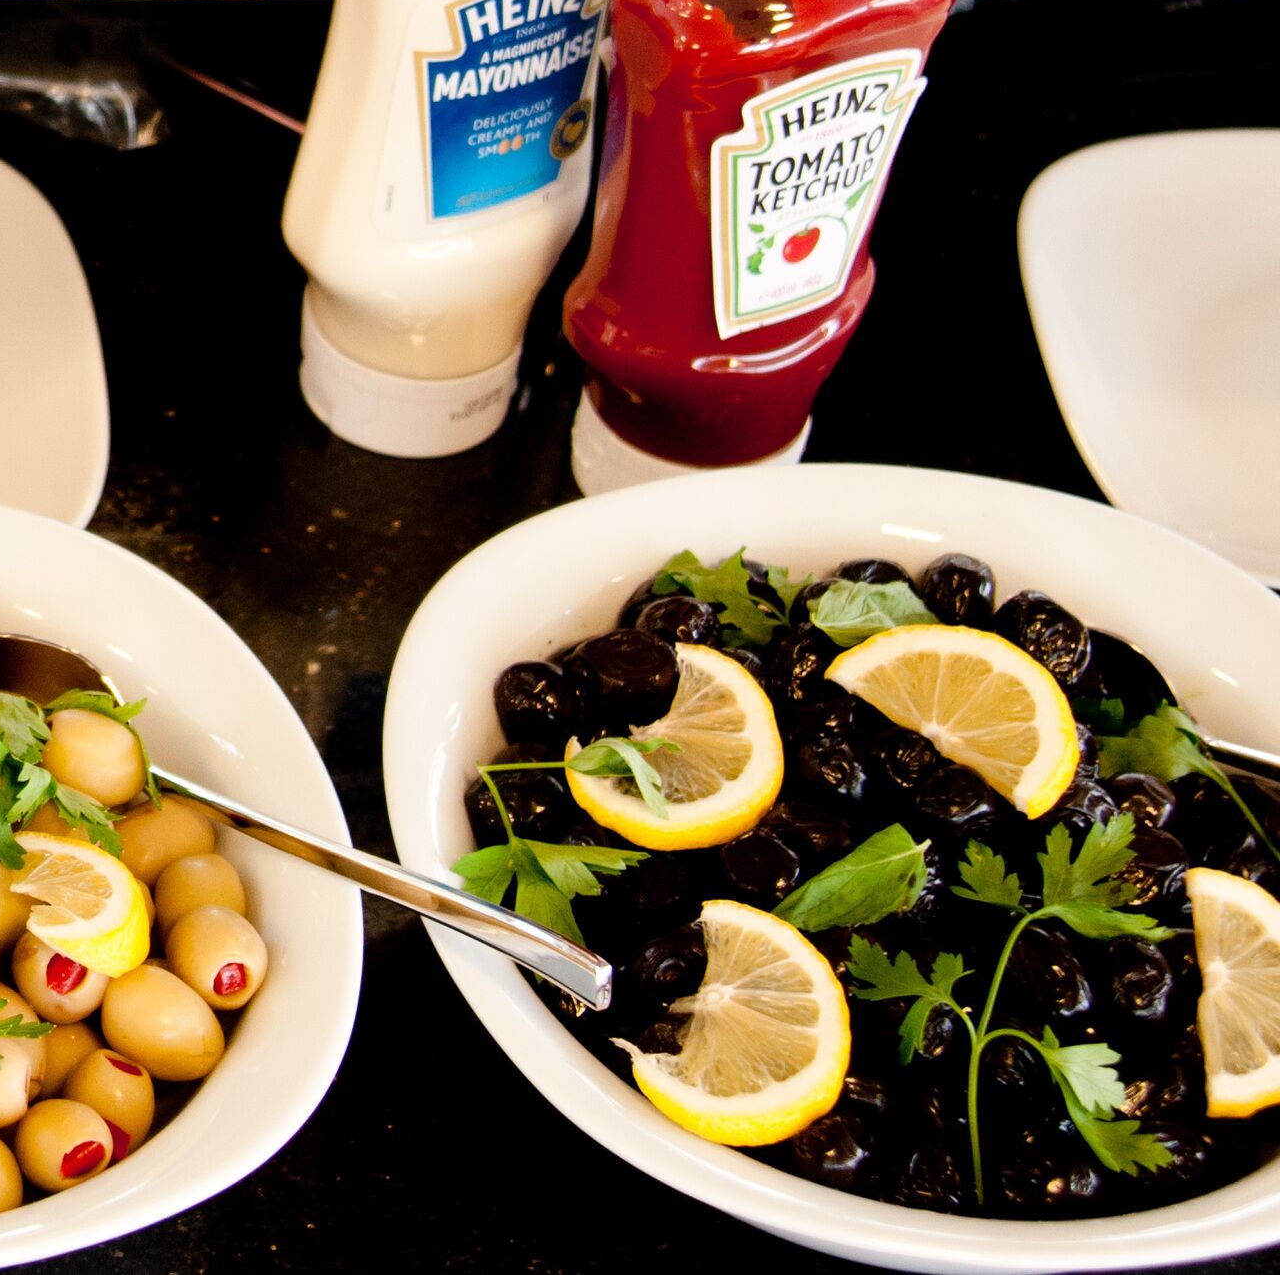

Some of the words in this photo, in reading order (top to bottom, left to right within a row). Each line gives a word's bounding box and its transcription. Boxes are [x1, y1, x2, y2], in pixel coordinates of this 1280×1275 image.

[433, 26, 595, 102] MAYONNAISE
[480, 52, 490, 65] A
[493, 28, 567, 64] MAGNIFICENT
[468, 124, 521, 146] CREAMY
[526, 112, 552, 130] AND
[472, 97, 553, 131] DELICIOUSLY
[781, 84, 889, 138] HEINZ
[749, 125, 885, 190] TOMATO
[750, 158, 873, 215] KETCHUP
